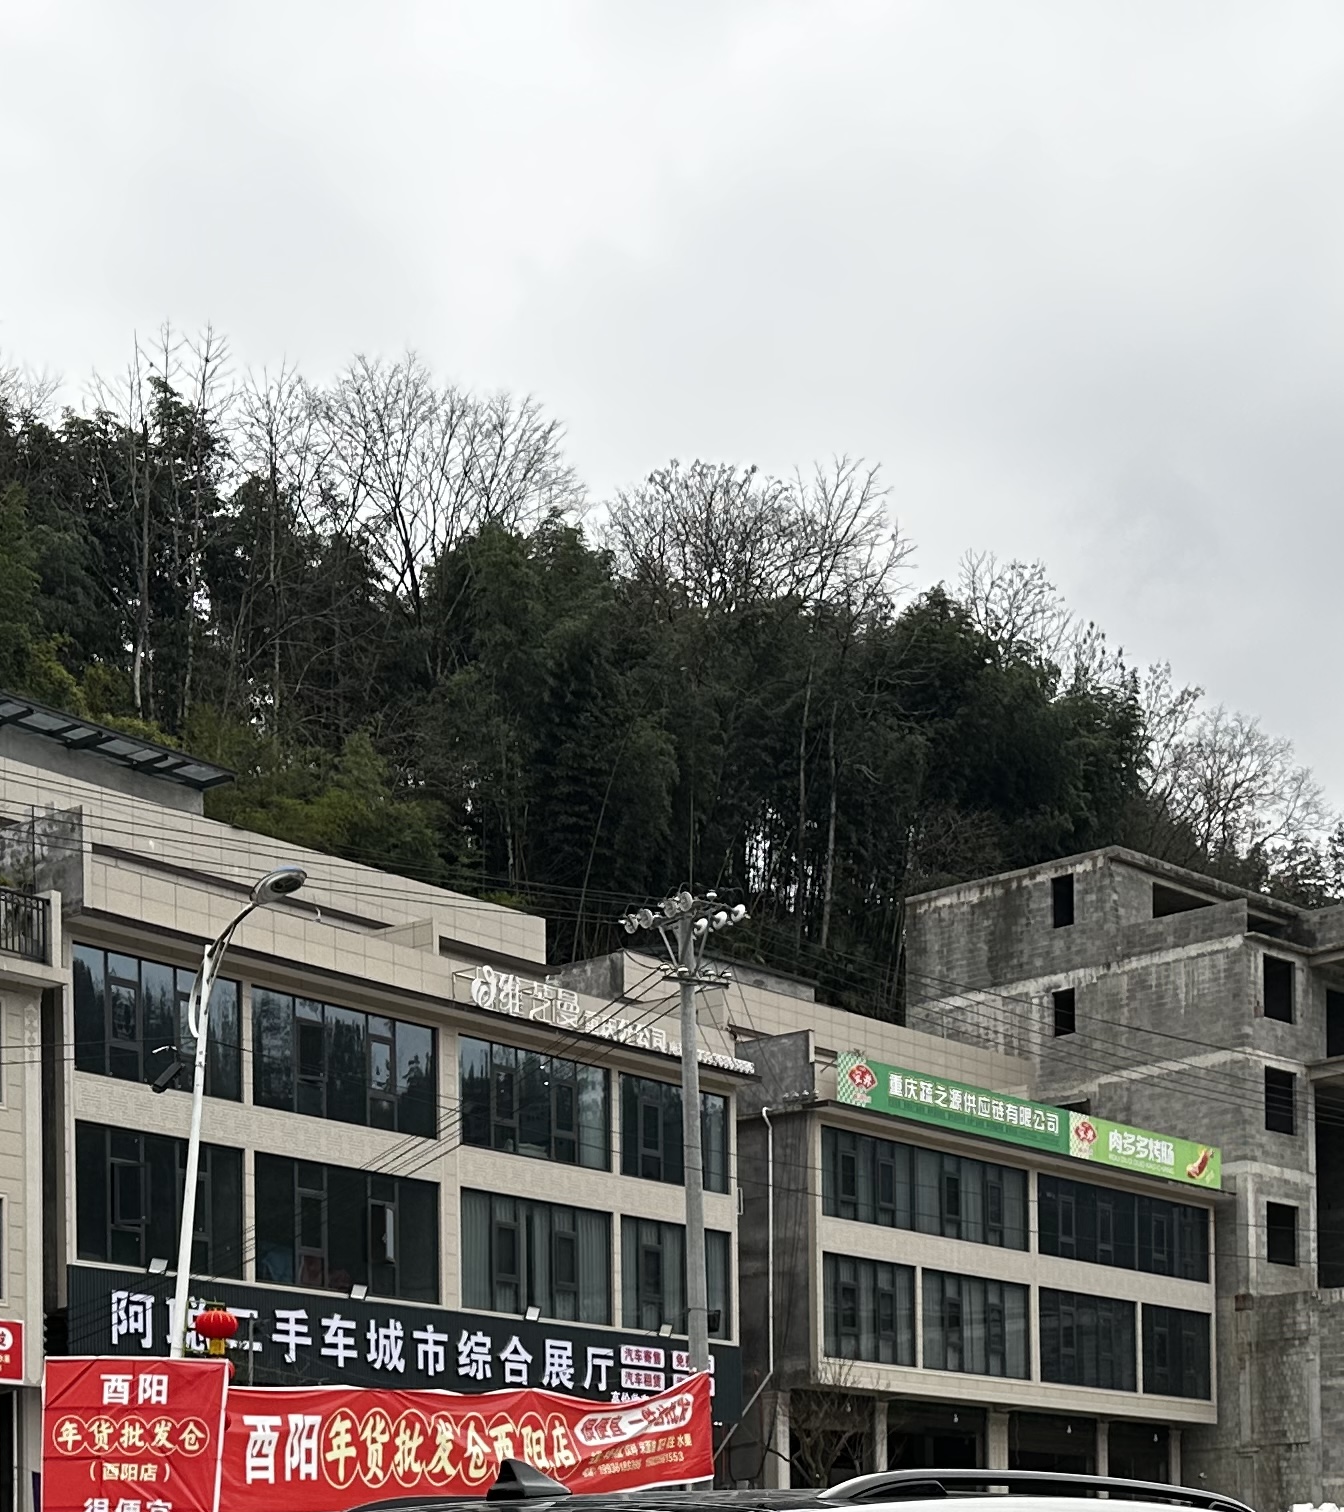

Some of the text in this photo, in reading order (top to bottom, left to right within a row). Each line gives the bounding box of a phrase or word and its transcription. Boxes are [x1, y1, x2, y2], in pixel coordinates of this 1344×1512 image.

[1108, 1129, 1175, 1166] 肉多多烤肠
[100, 1373, 169, 1405] 酉阳
[57, 1420, 207, 1451] 年货批发仓
